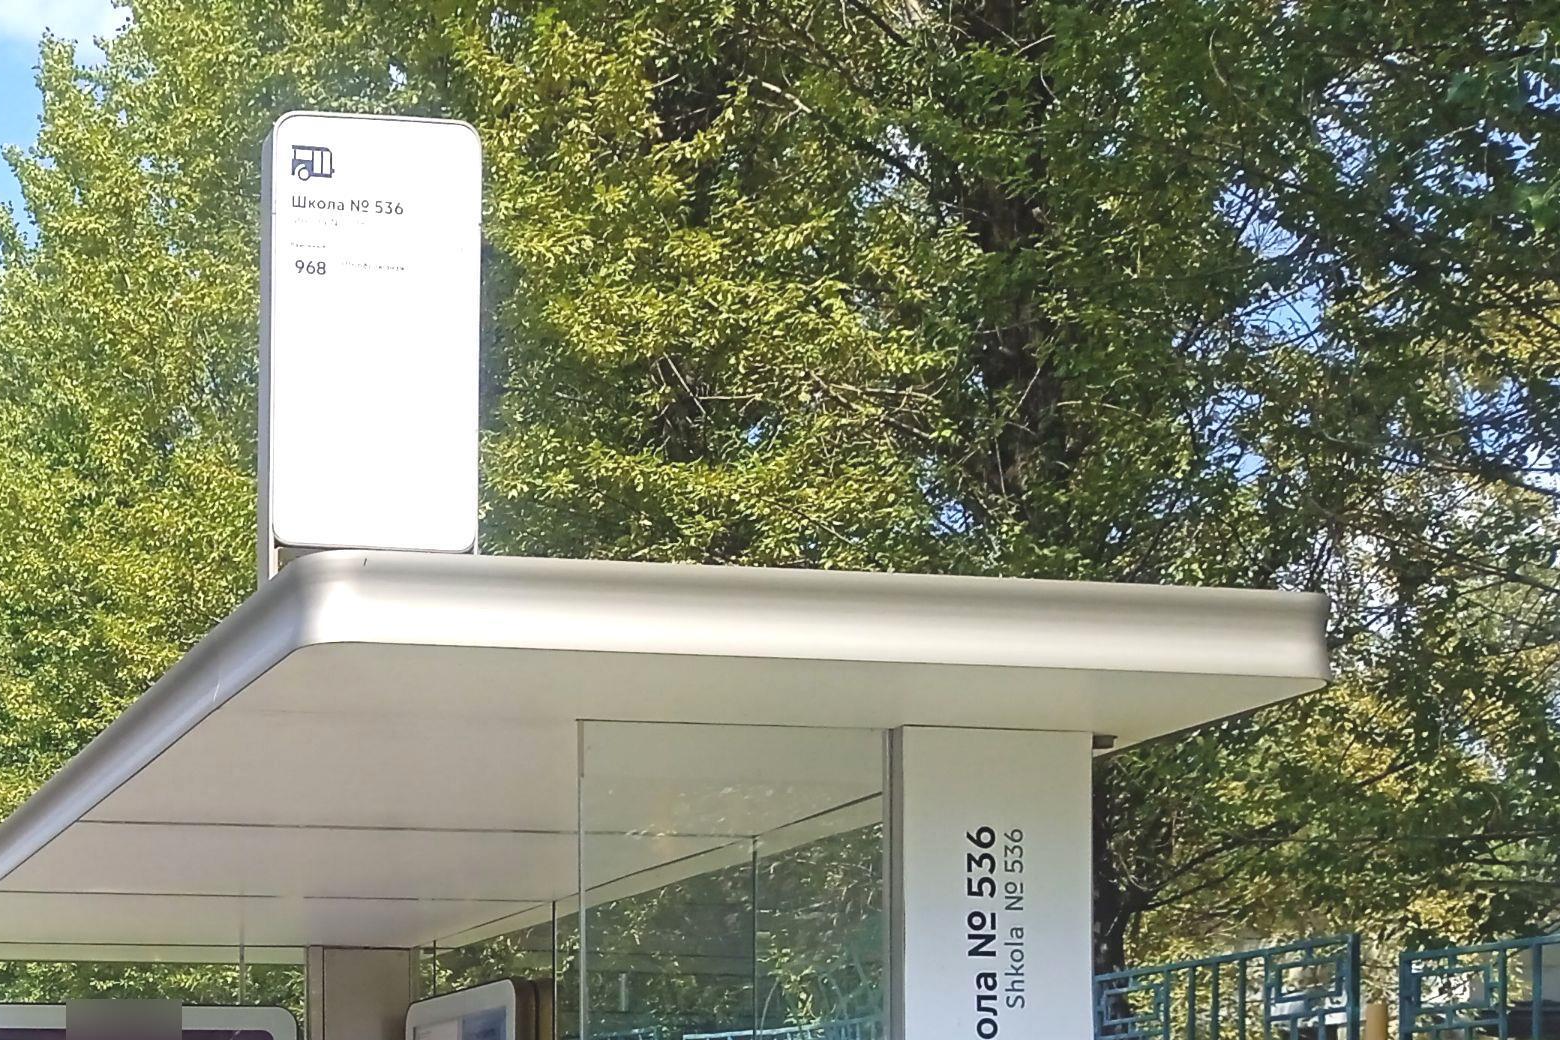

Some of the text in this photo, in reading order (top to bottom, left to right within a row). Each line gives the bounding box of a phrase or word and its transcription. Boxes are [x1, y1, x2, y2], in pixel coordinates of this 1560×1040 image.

[292, 196, 404, 215] Школа № 536
[295, 260, 327, 275] 968
[966, 825, 997, 898] 536
[966, 910, 997, 958] №
[1003, 828, 1025, 1010] Shkola № 536
